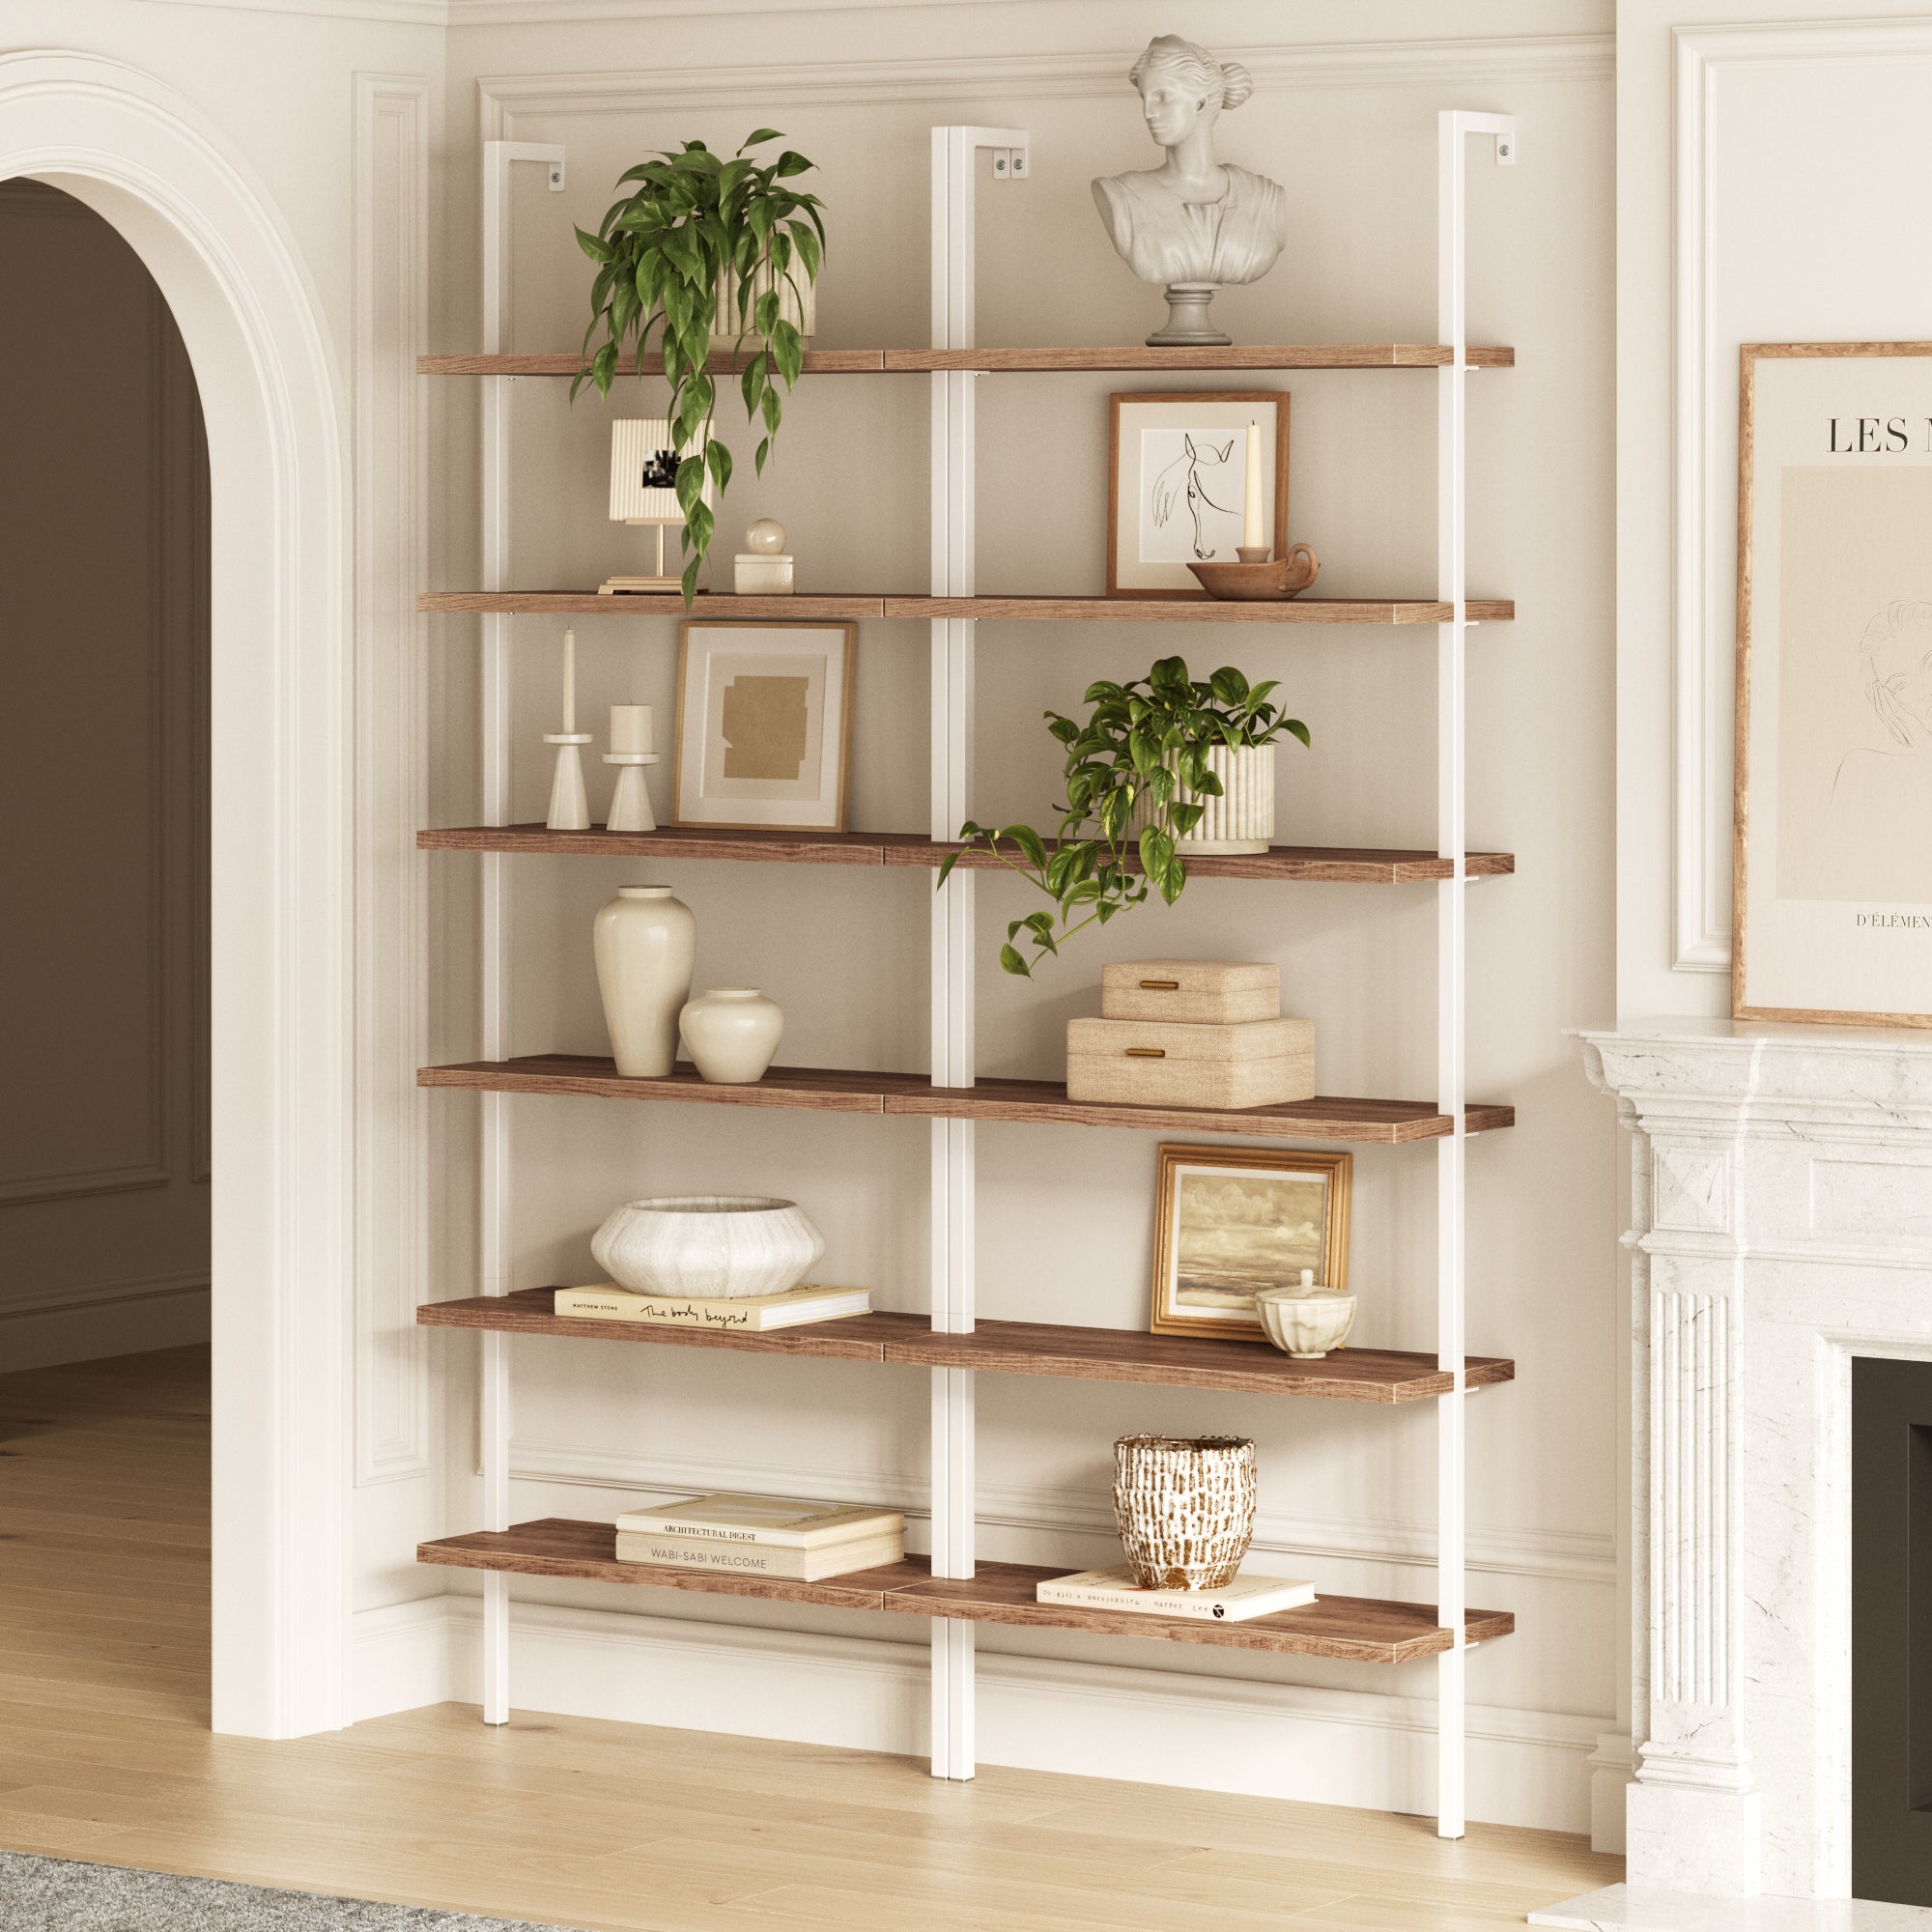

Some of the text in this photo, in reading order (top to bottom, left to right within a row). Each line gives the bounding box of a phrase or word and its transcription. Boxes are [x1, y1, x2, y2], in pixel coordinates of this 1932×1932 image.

[1826, 416, 1908, 453] LES
[1857, 911, 1932, 928] D'ÉLÉMEN
[640, 1304, 748, 1328] The body beyond
[663, 1524, 756, 1542] ARCHITECTURAL DIGEST
[651, 1548, 767, 1569] WABI-SABI WELCOME
